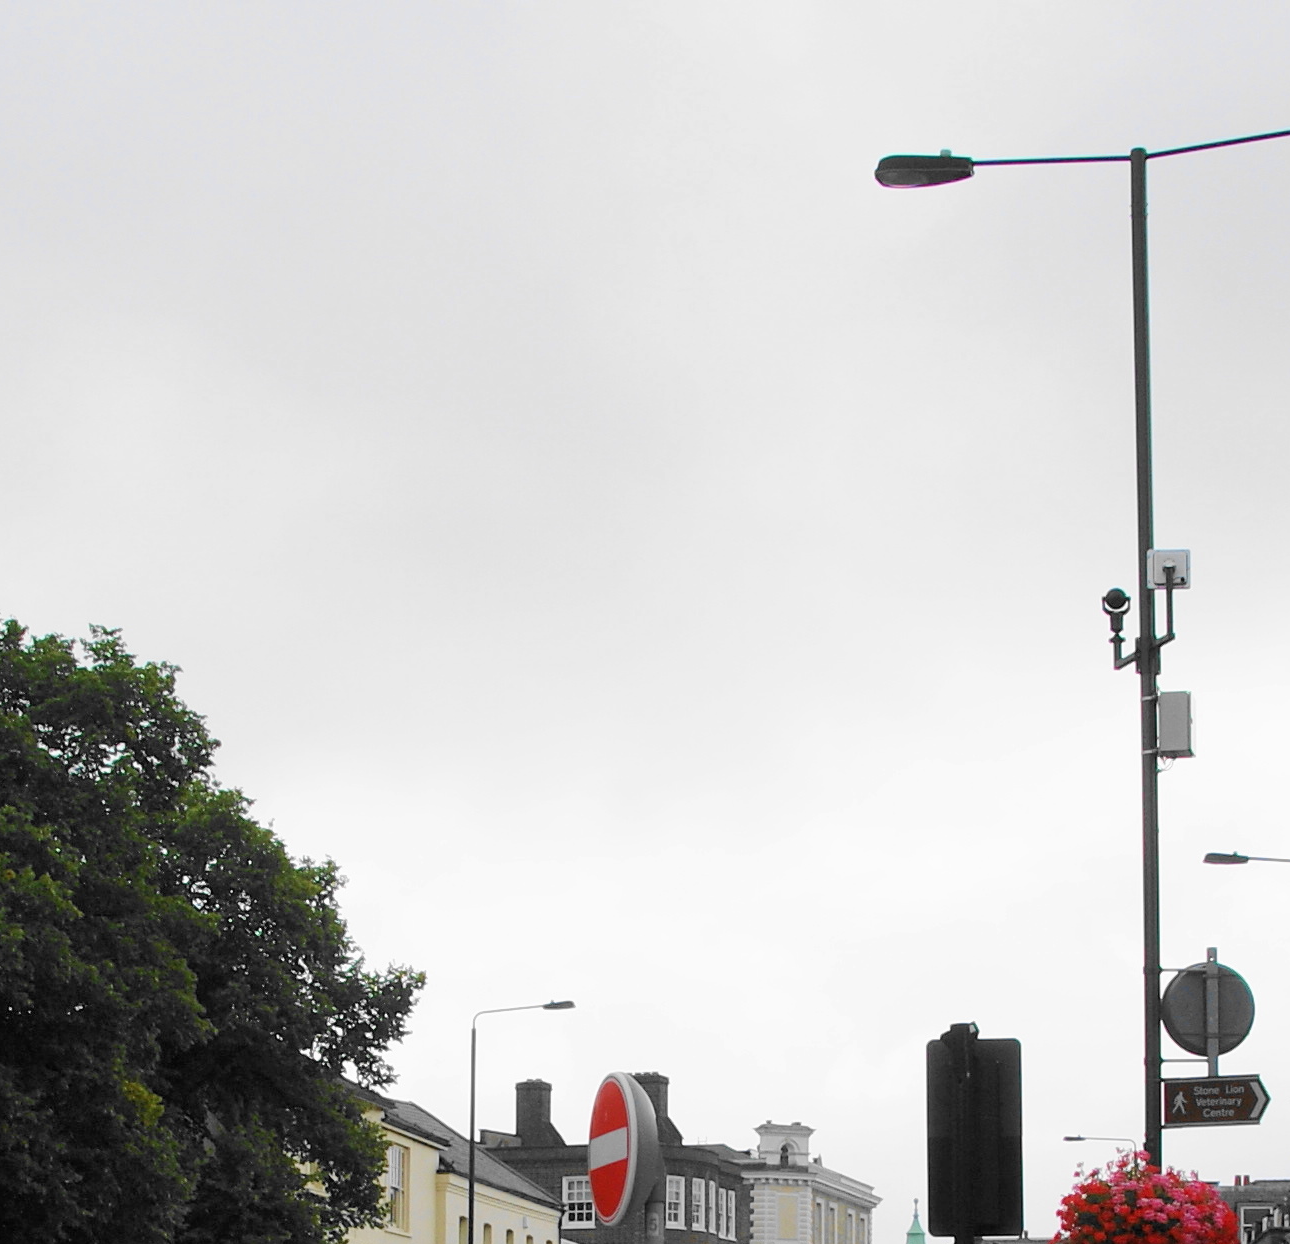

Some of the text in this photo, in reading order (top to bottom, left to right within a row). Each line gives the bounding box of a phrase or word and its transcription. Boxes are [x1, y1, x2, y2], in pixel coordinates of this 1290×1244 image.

[1193, 1085, 1245, 1096] Stone Lion
[1195, 1096, 1242, 1107] Veterinary
[1202, 1108, 1235, 1118] Centre
